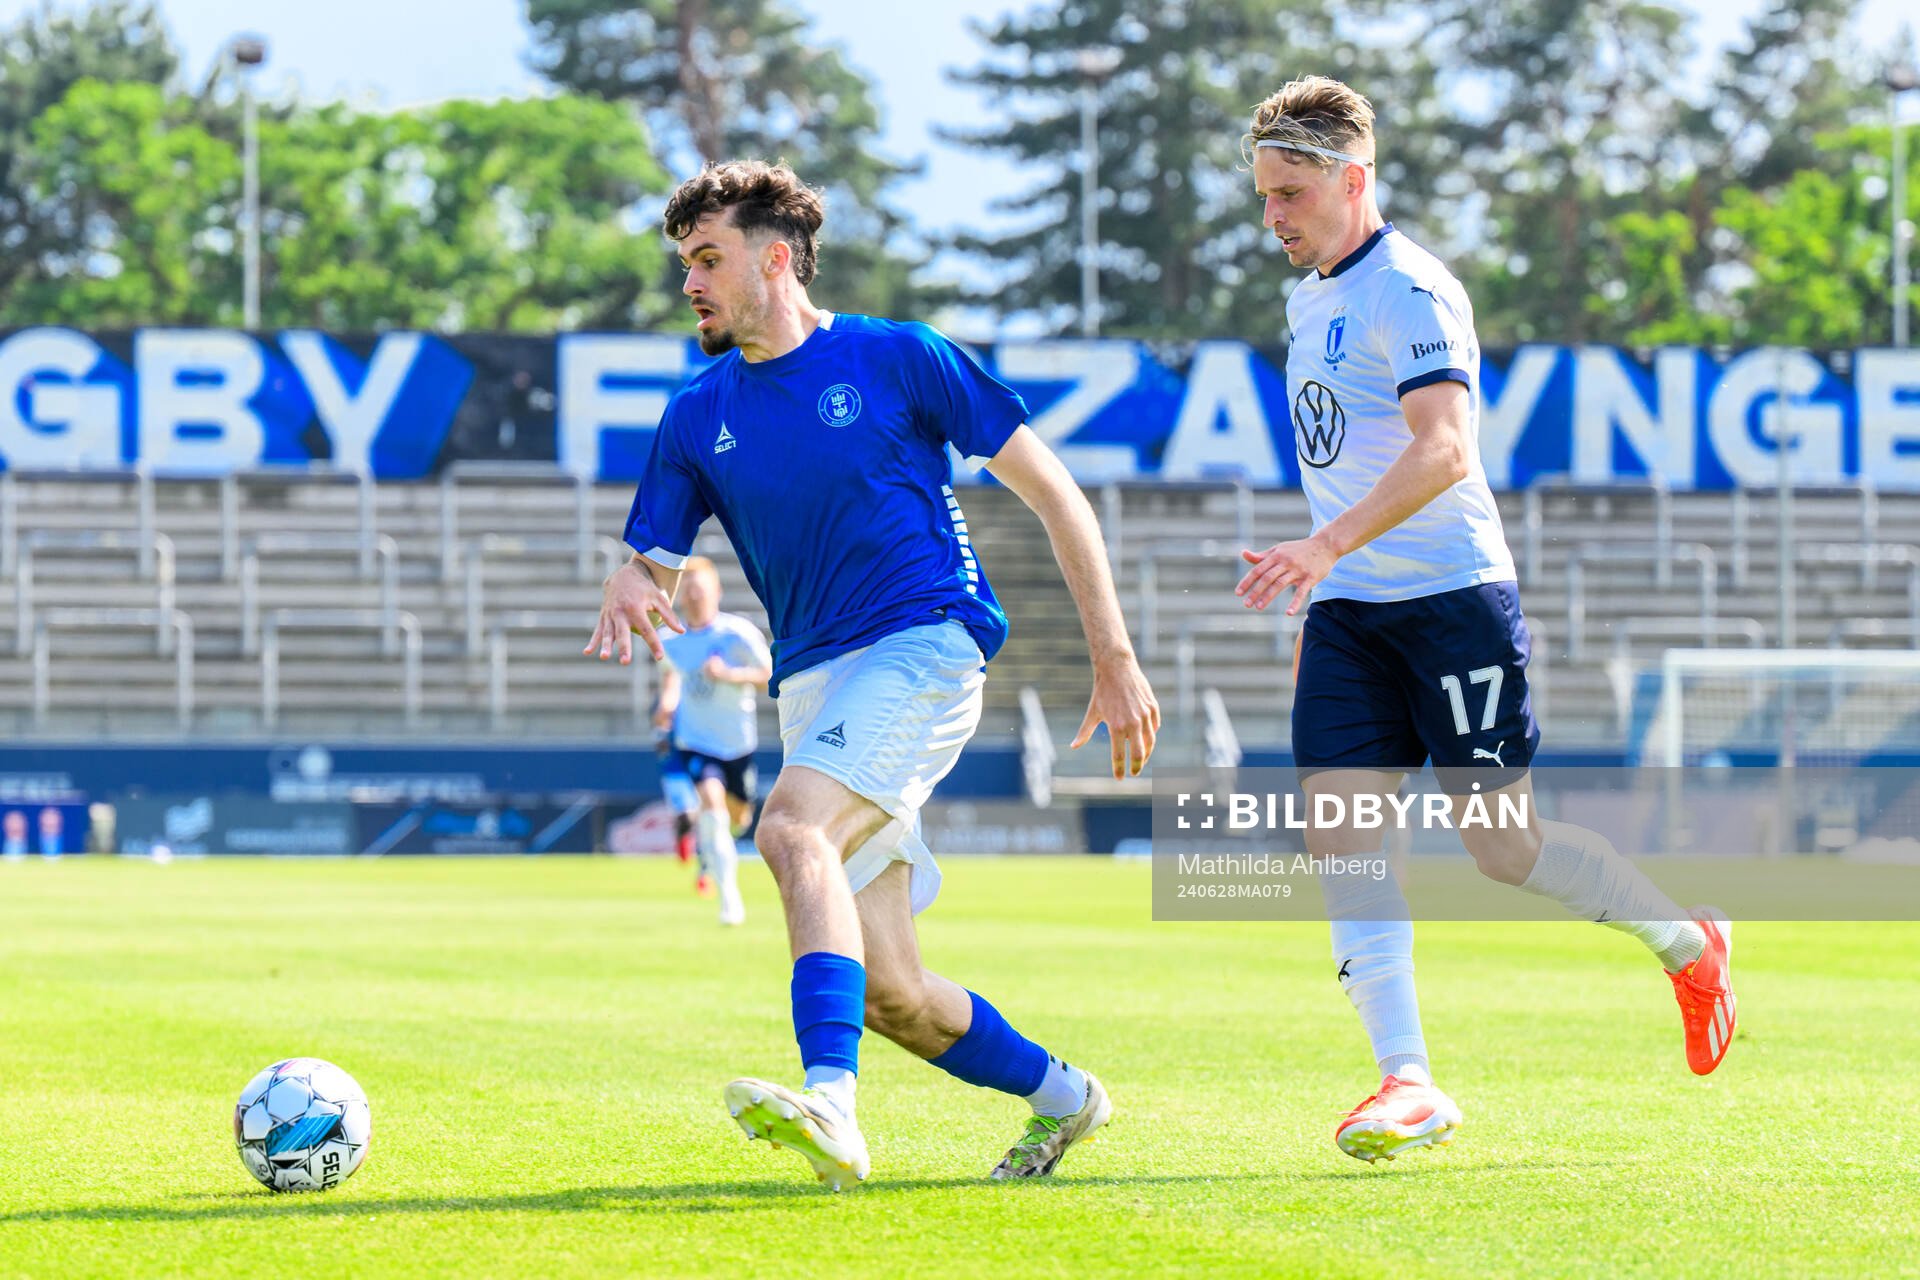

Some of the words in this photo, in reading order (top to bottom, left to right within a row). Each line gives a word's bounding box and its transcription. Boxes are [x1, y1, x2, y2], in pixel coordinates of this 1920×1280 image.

[1410, 340, 1460, 360] Booz
[714, 440, 737, 454] SELECT
[1440, 664, 1504, 736] 17
[816, 734, 847, 750] SELECT
